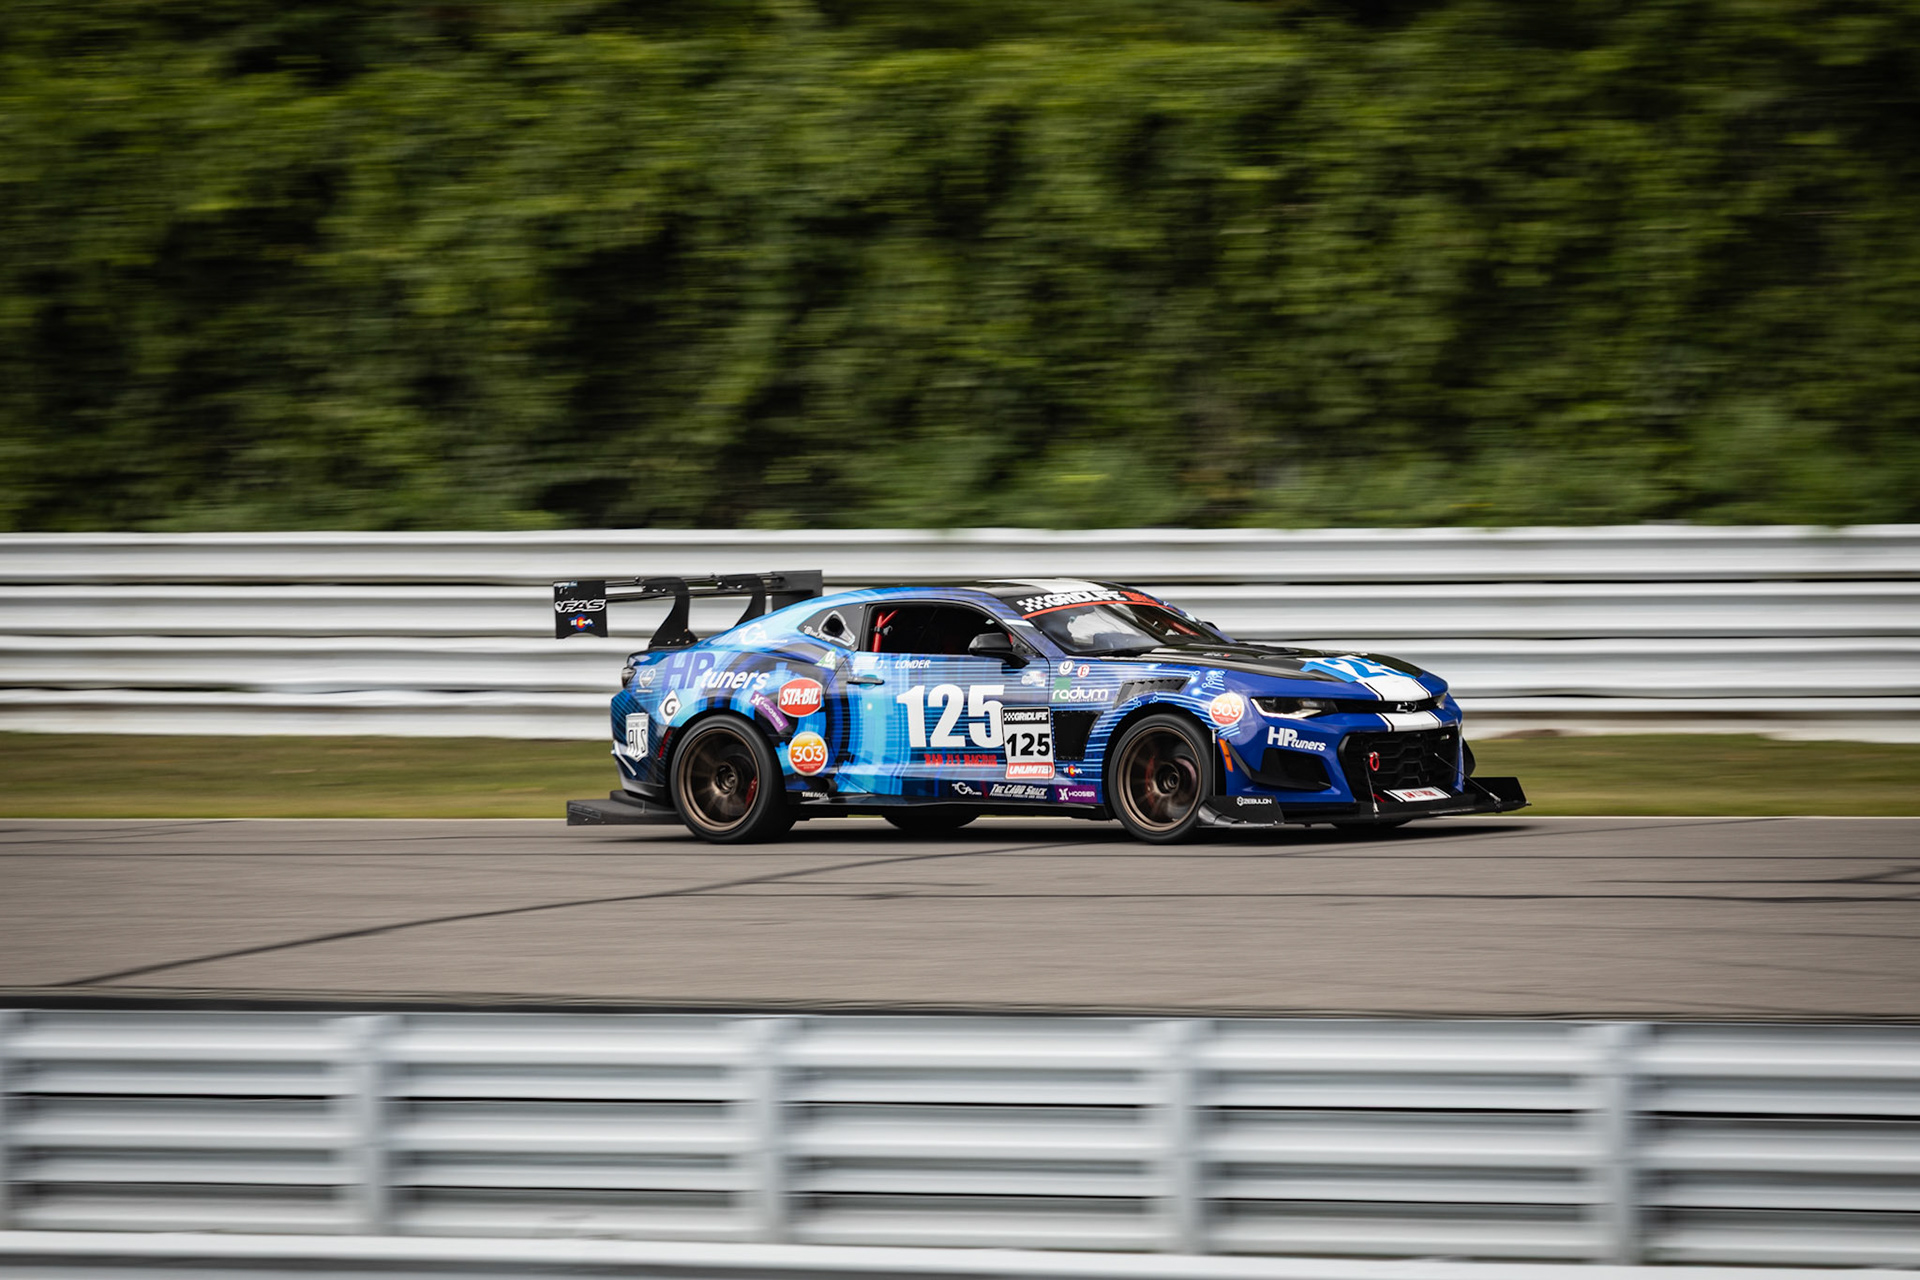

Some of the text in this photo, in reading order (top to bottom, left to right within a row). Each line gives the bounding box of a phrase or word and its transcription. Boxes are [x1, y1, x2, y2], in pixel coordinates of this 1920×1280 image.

[781, 687, 820, 706] STA-BIL
[1052, 686, 1109, 700] radium
[664, 698, 677, 716] G
[896, 683, 1005, 748] 125
[1212, 702, 1241, 718] 303
[1014, 711, 1049, 721] GRIDLIFE
[1006, 732, 1051, 757] 125
[792, 745, 824, 763] 303
[1009, 764, 1053, 775] UNLIMITED
[1068, 790, 1096, 798] HOOSIER
